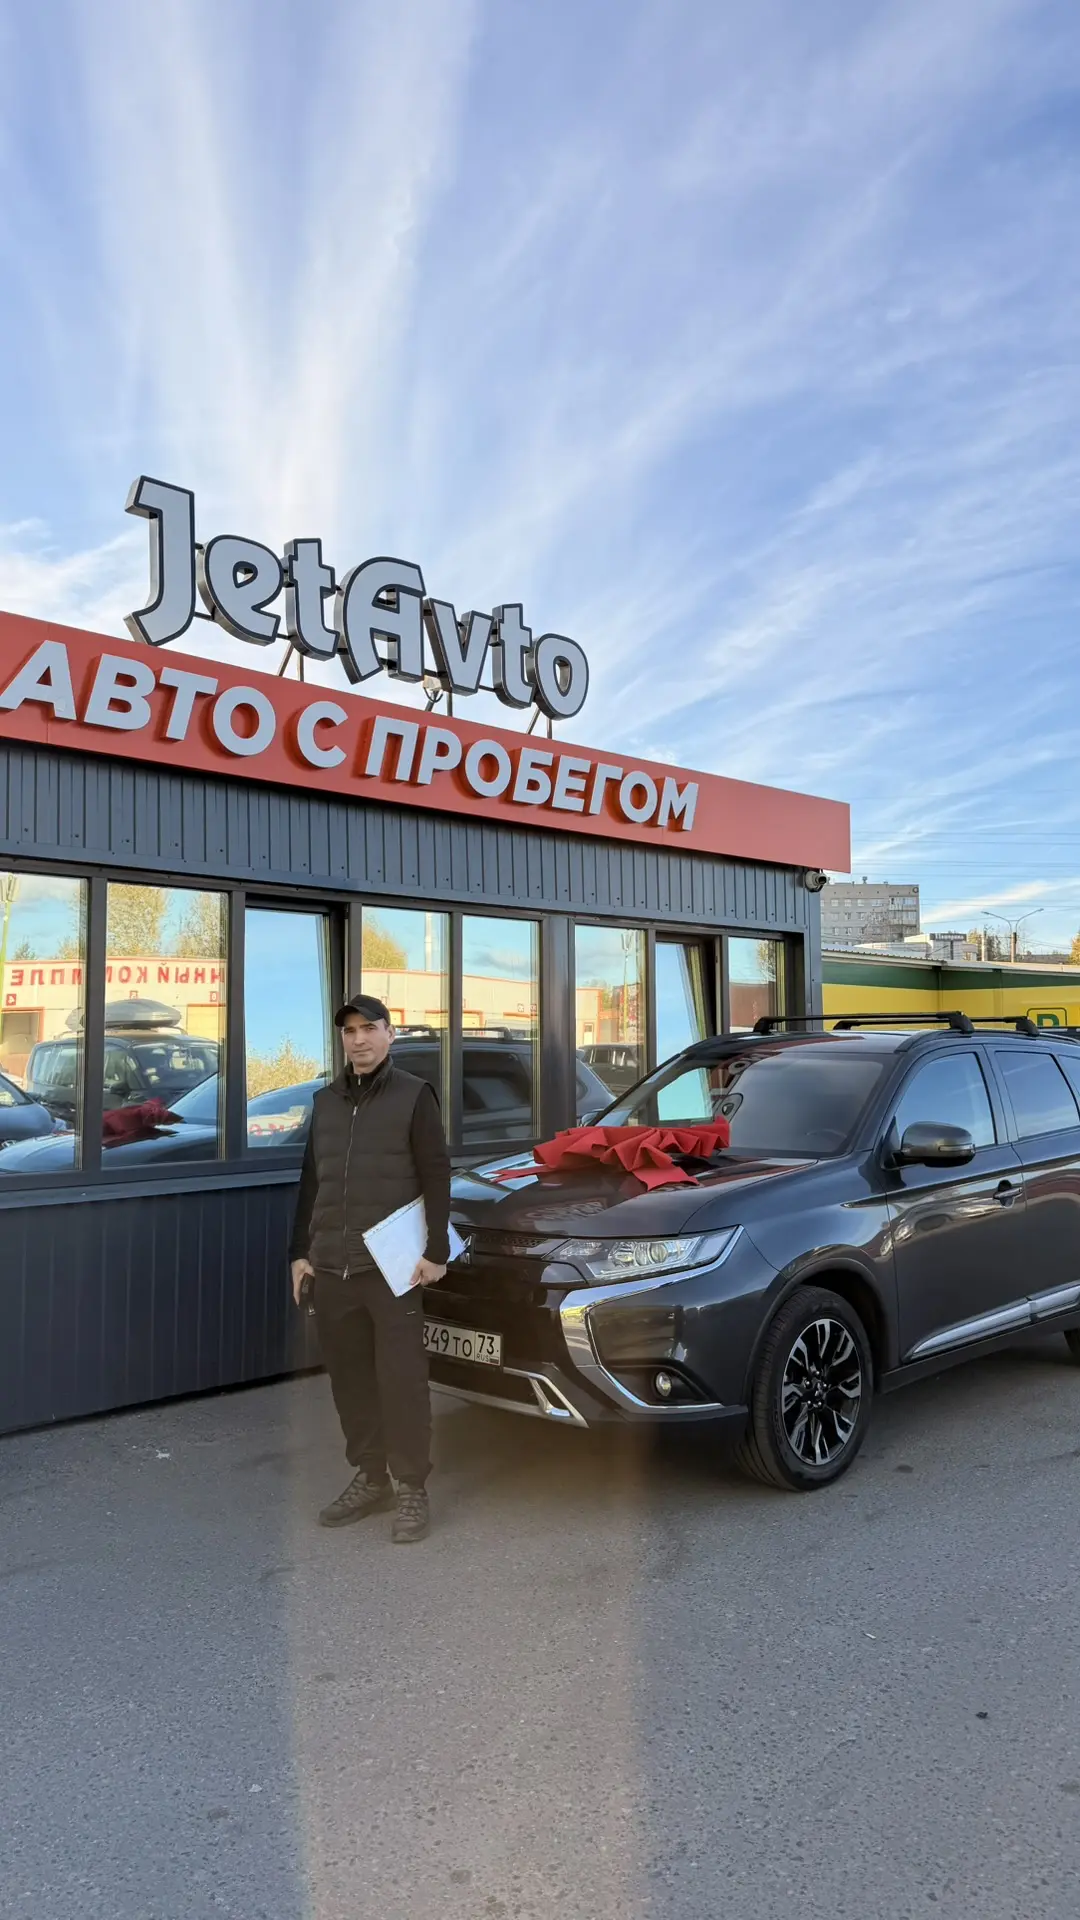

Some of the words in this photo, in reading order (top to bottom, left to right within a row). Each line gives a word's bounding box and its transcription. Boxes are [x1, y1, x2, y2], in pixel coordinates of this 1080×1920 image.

[125, 475, 590, 721] JetAvto
[0, 639, 277, 757] АВТО
[296, 700, 347, 769] С
[365, 716, 699, 832] ПРОБЕГОМ
